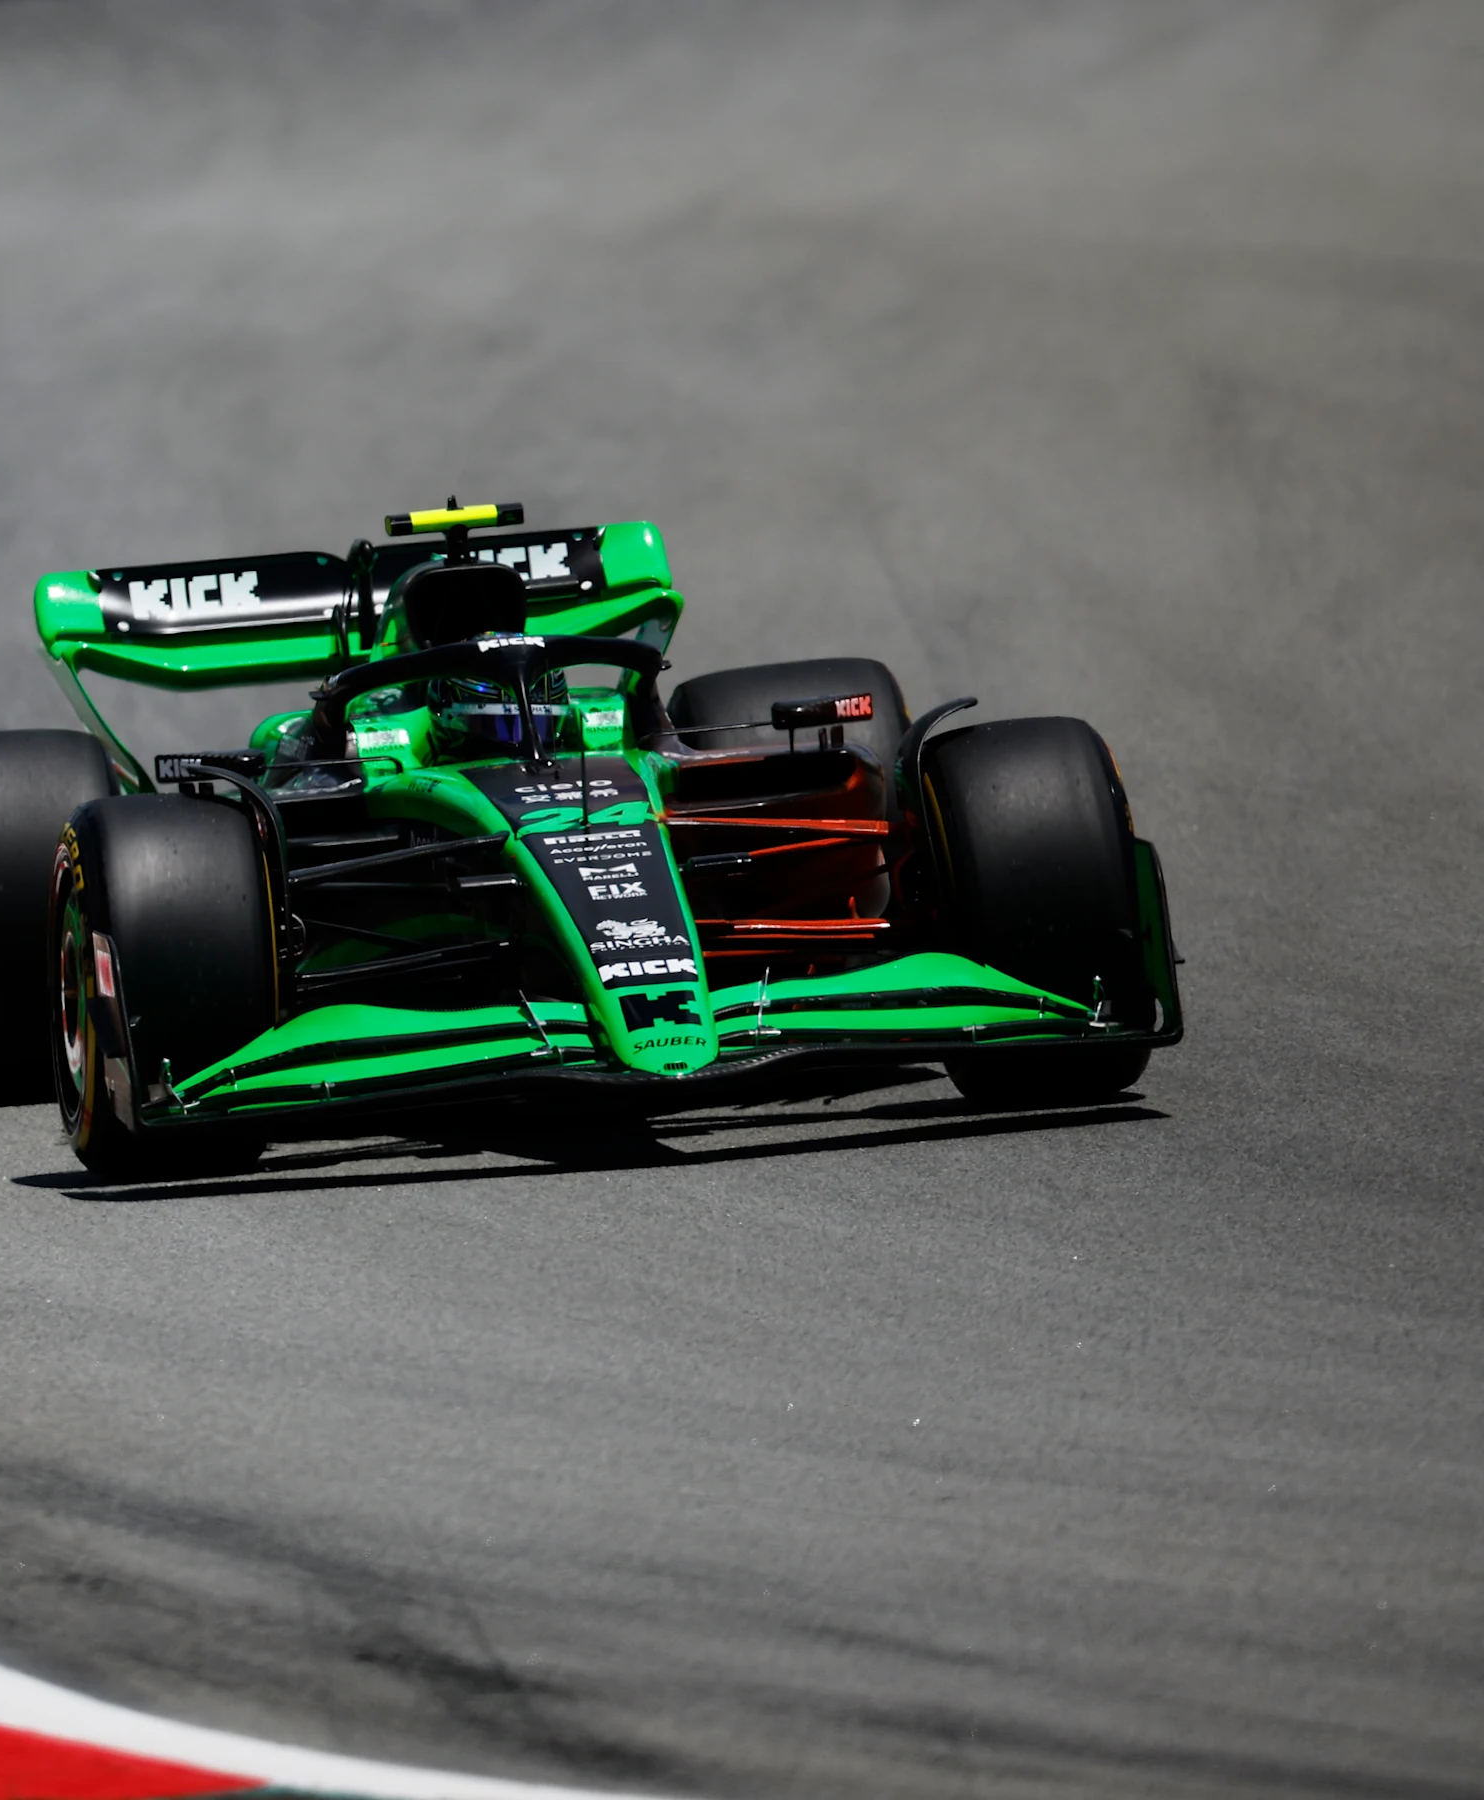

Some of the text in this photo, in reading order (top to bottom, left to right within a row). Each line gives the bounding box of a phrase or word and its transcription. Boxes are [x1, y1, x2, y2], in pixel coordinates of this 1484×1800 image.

[128, 570, 261, 621] KICK
[477, 636, 545, 653] KICK
[834, 695, 872, 718] KICK
[517, 801, 657, 839] 24
[543, 829, 642, 845] PIRELLI
[582, 871, 639, 881] MARELLI
[587, 881, 647, 900] FIX
[592, 891, 648, 900] NETWORK
[590, 935, 688, 951] SINGHA
[598, 958, 698, 983] KICK
[619, 990, 703, 1033] K
[633, 1036, 707, 1054] SAUBER
